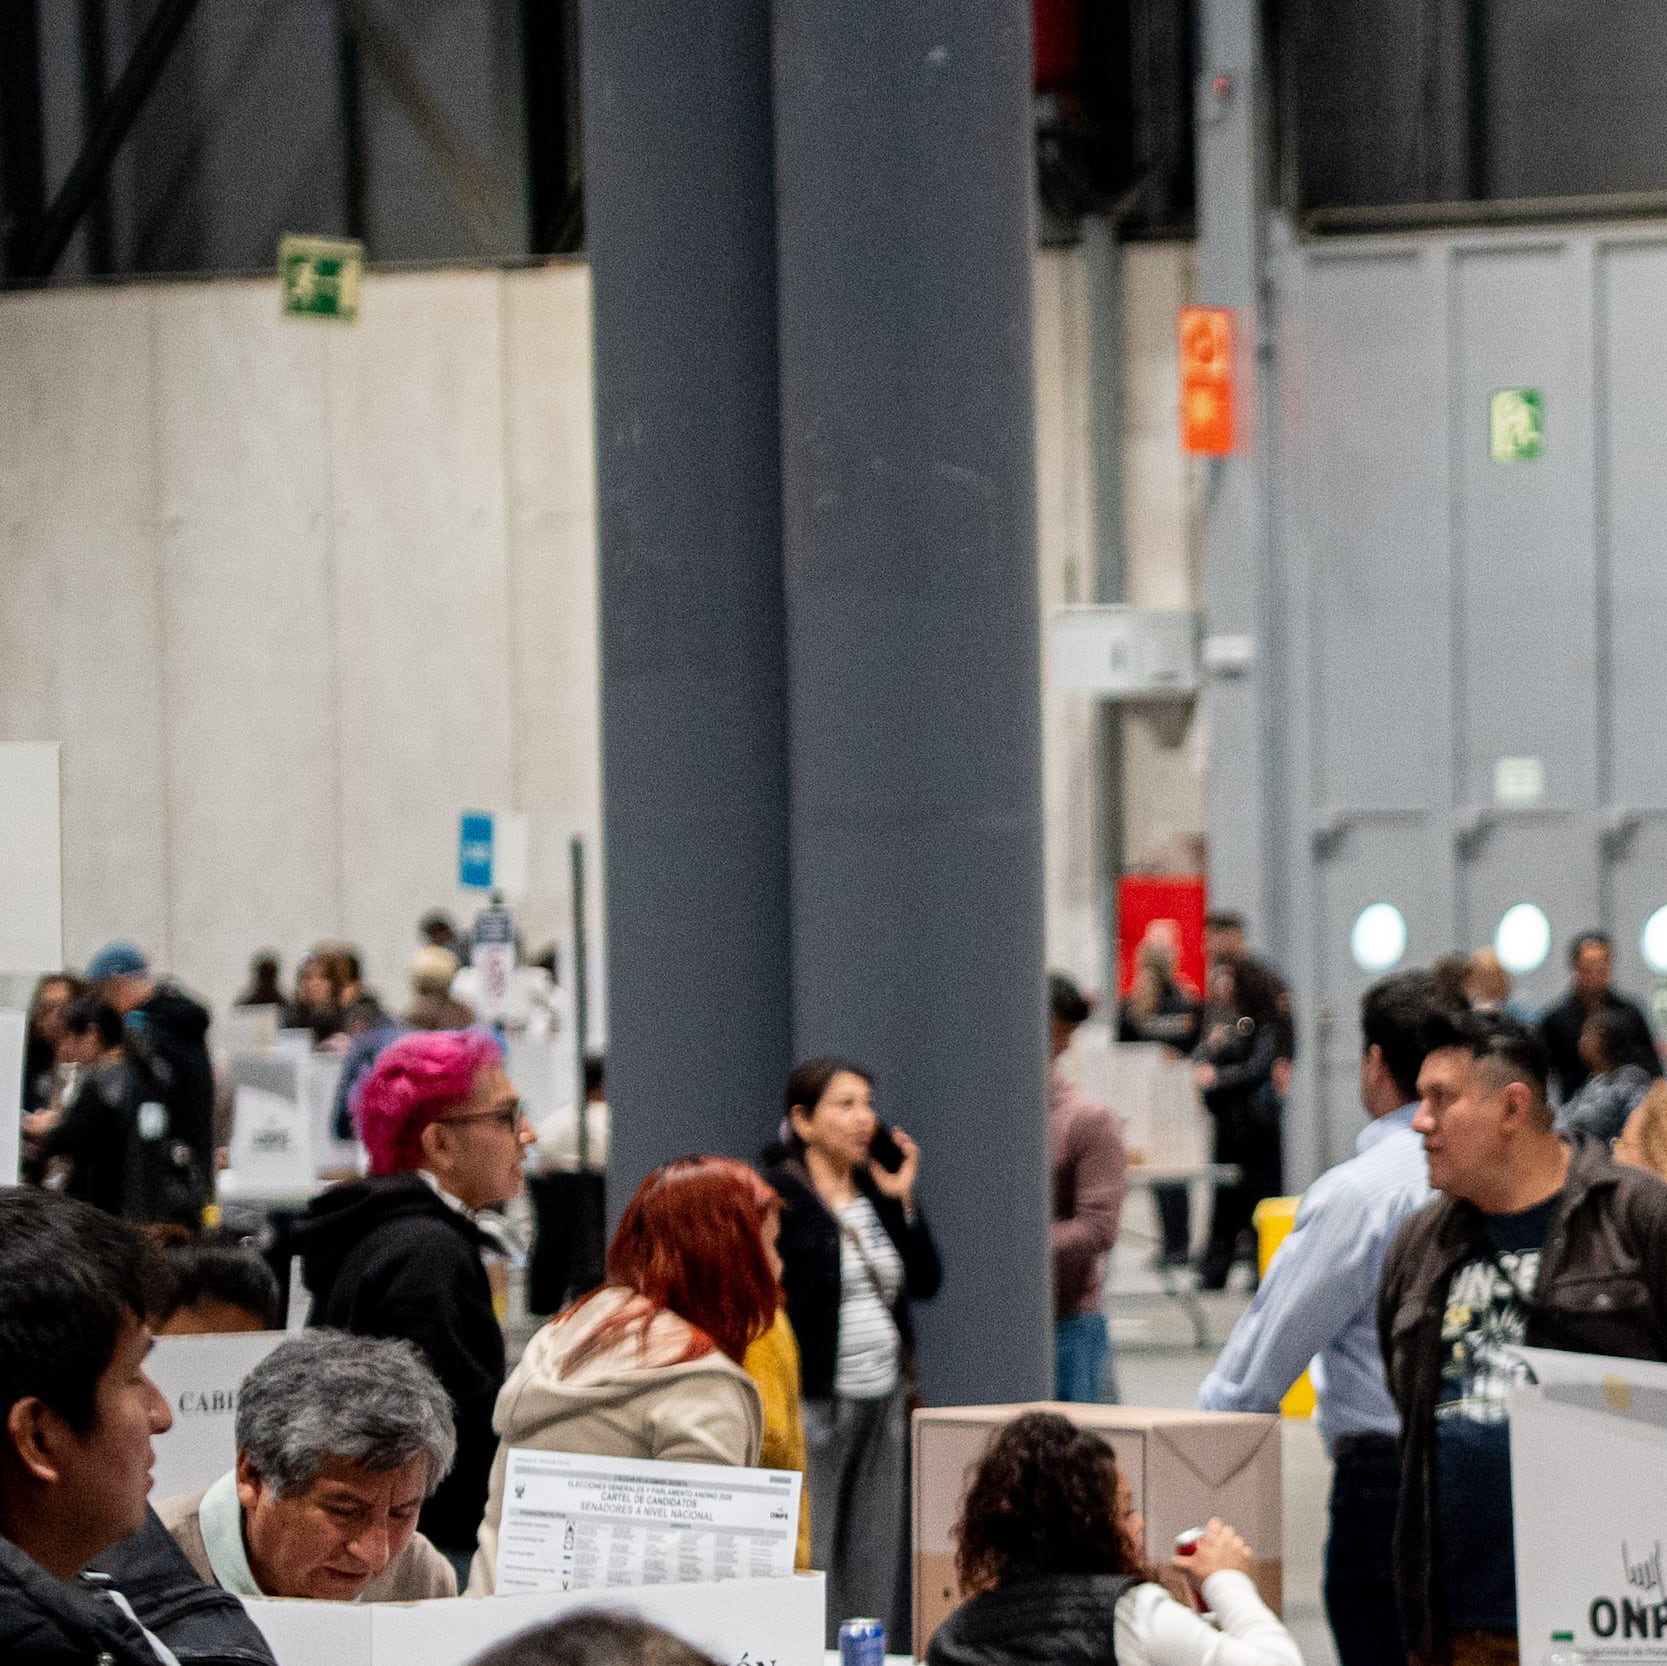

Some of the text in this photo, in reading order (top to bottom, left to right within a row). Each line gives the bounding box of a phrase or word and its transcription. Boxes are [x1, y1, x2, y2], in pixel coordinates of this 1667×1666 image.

[178, 1389, 238, 1412] CABI
[601, 1492, 698, 1508] CARTEL DE CANDIDATOS
[579, 1501, 633, 1515] SENADORES
[635, 1504, 643, 1515] A
[643, 1506, 669, 1518] NIVEL
[671, 1509, 713, 1522] NACIONAL
